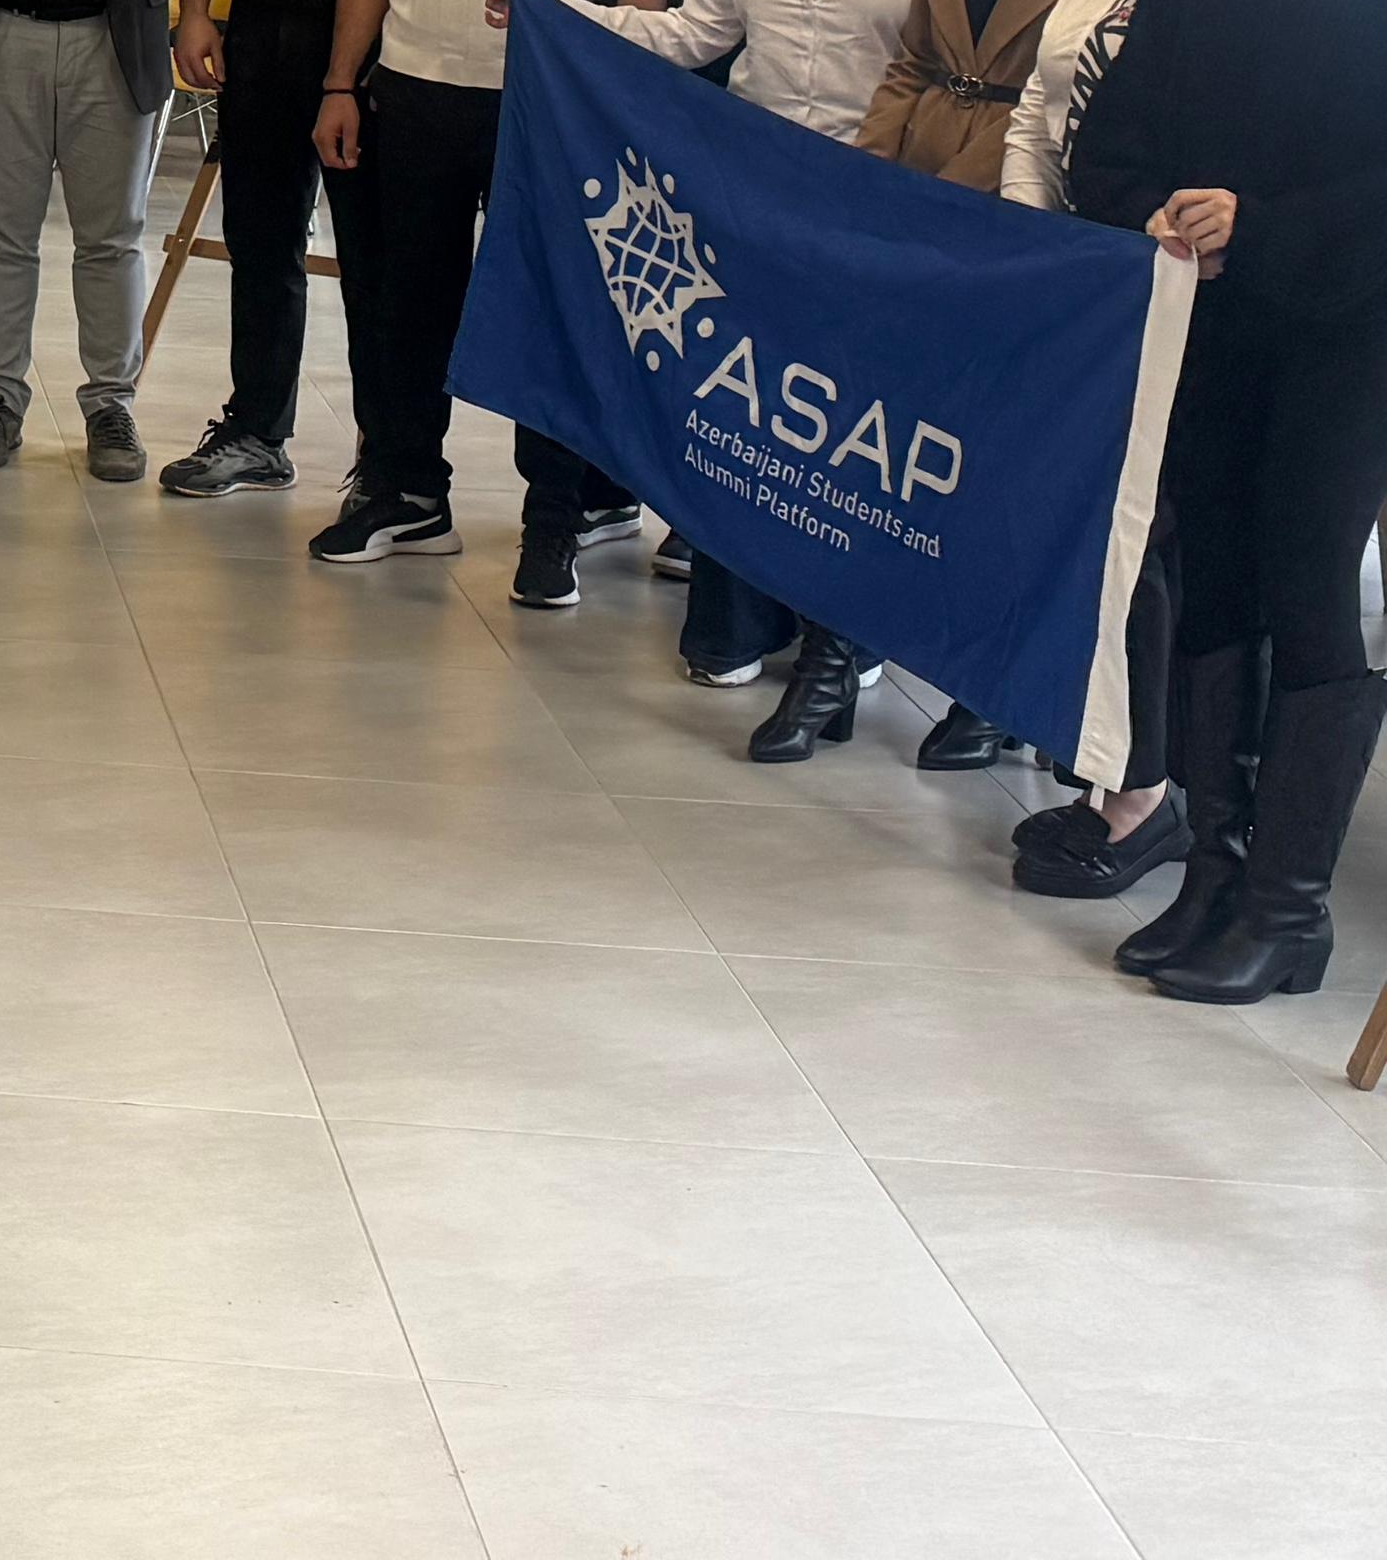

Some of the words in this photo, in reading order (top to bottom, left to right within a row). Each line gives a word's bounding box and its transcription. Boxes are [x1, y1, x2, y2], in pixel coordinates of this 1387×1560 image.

[685, 408, 805, 490] Azerbaijani
[806, 471, 903, 539] Students
[903, 527, 941, 559] and
[693, 335, 963, 502] ASAP
[683, 442, 751, 501] Alumni
[755, 483, 851, 552] Platform
